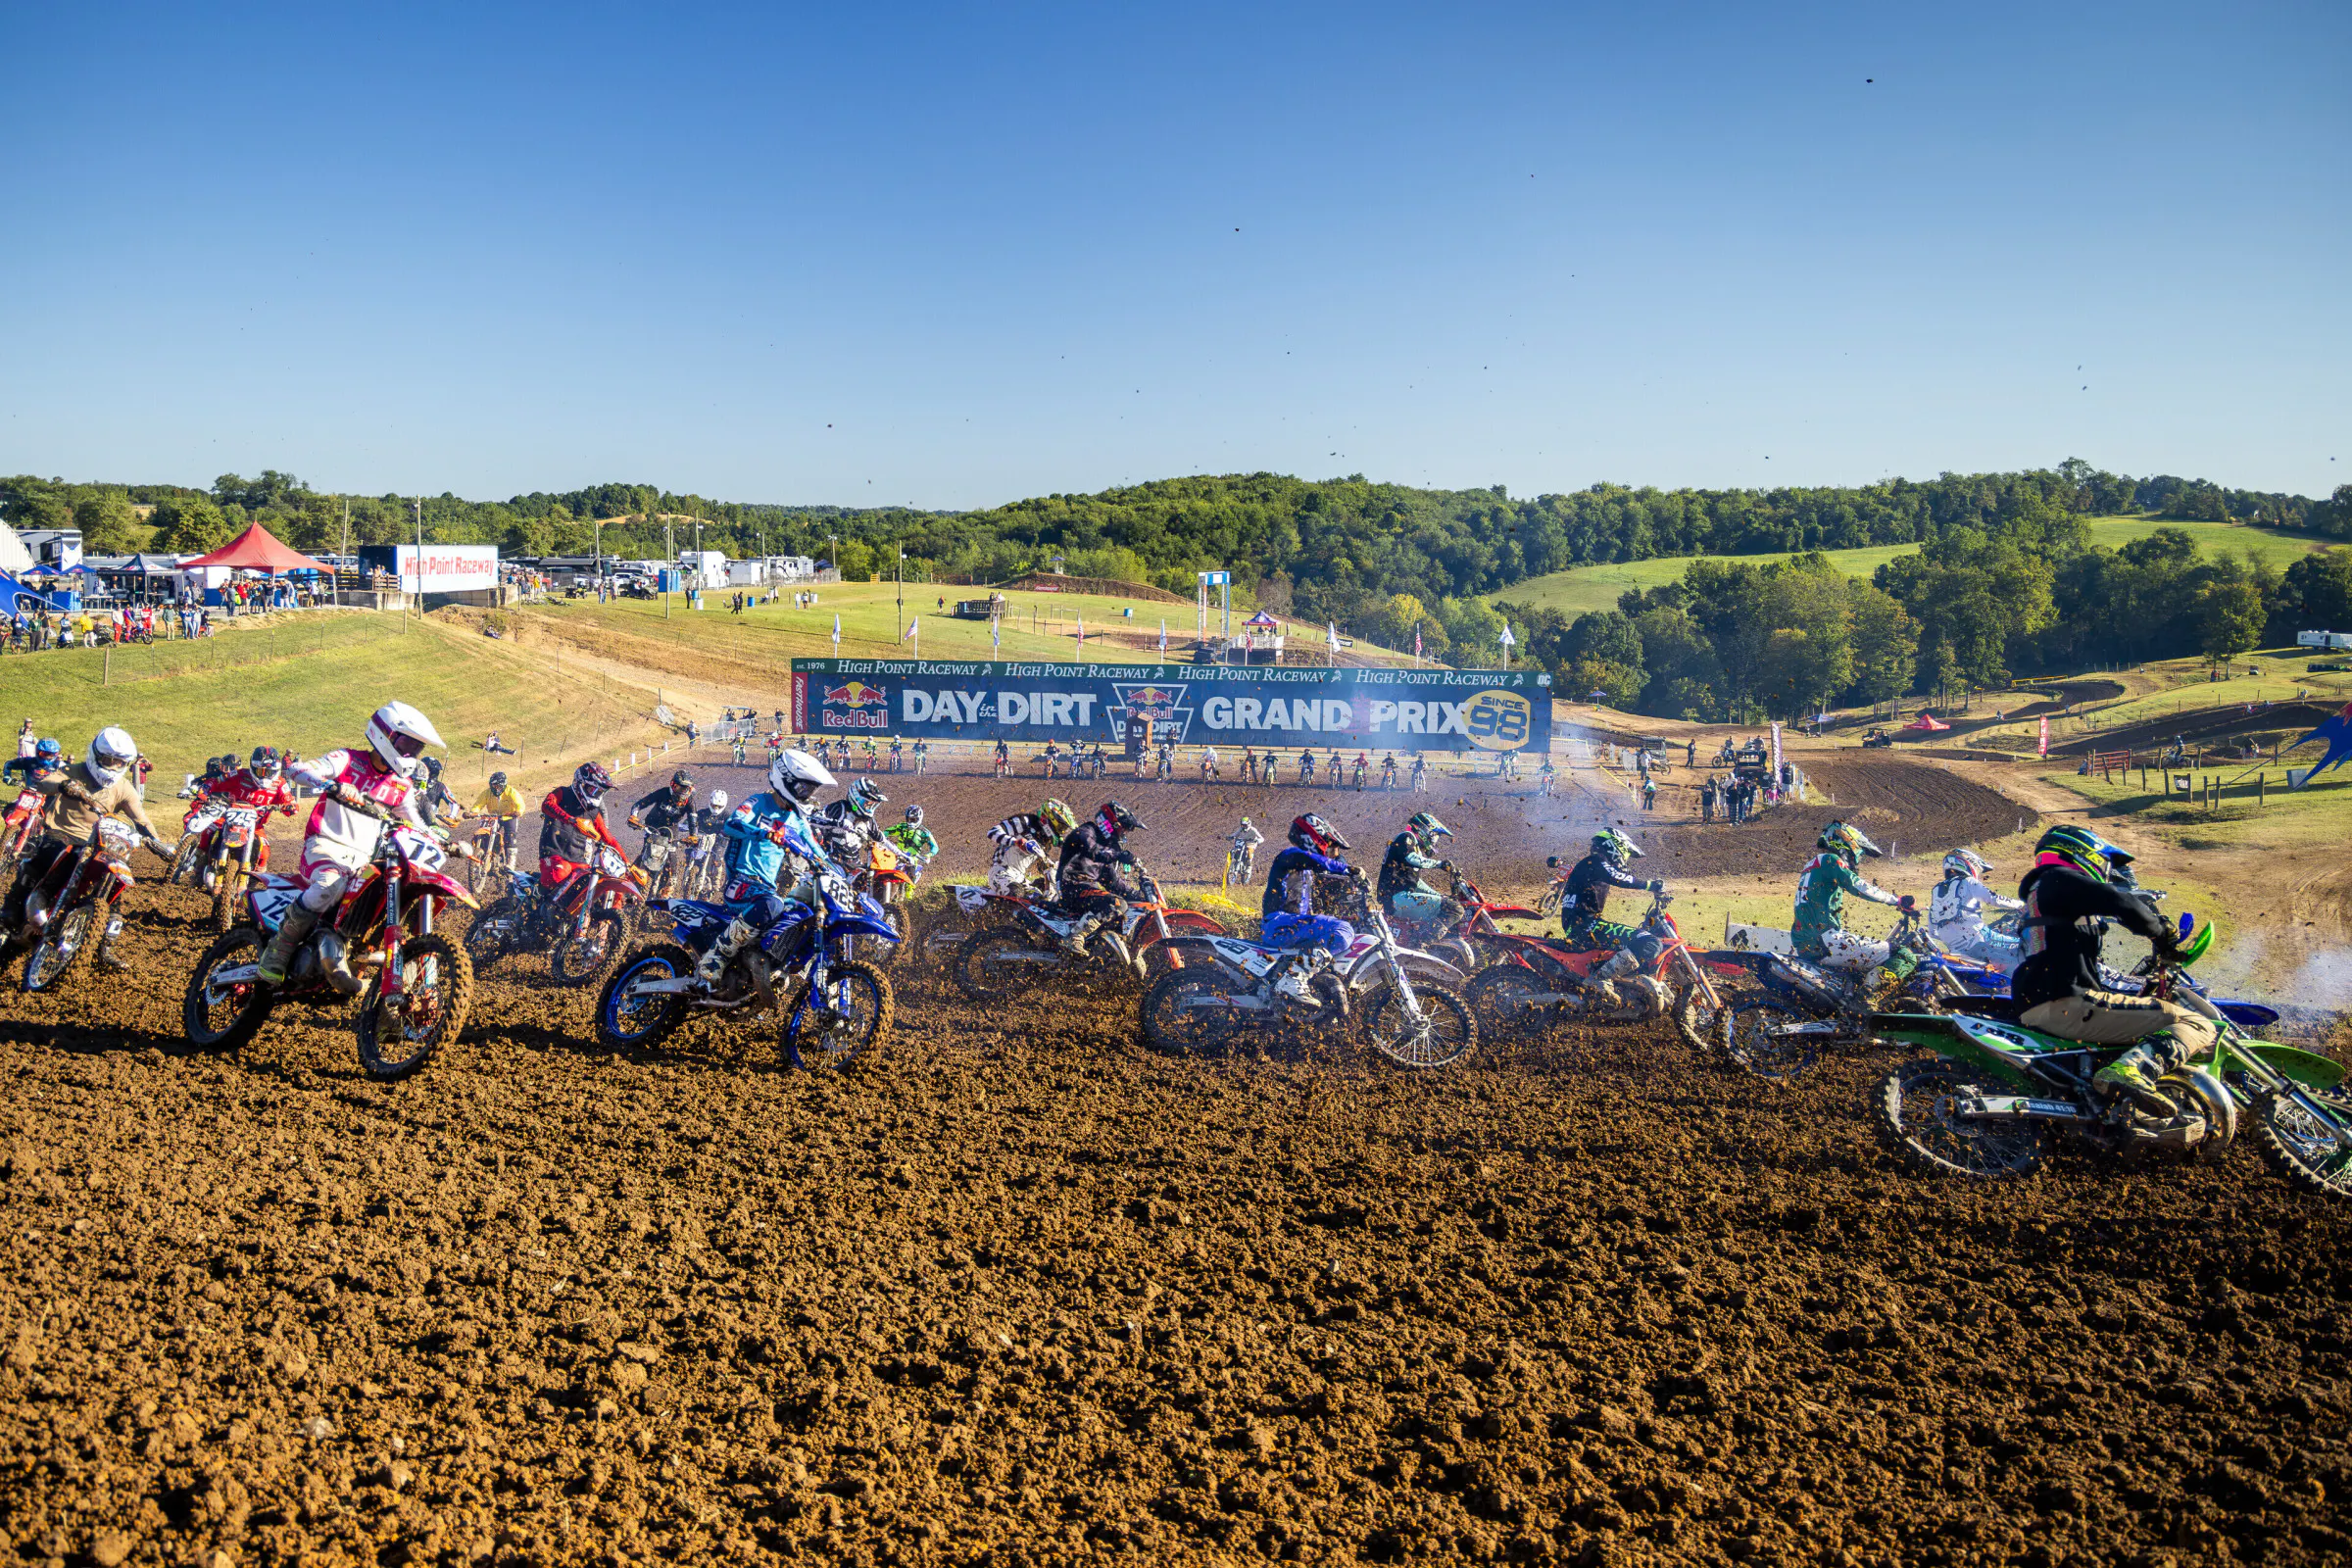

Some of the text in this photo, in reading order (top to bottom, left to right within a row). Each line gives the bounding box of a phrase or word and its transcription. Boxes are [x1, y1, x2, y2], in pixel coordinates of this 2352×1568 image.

[405, 556, 495, 579] High Point Raceway
[795, 675, 805, 730] FASTHOUSE
[823, 709, 888, 728] Red Bull
[903, 689, 987, 723] DAY
[998, 692, 1097, 726] DIRT
[1151, 707, 1174, 720] Bull
[1202, 696, 1472, 735] GRAND PRIX
[1481, 696, 1526, 710] SINCE
[1468, 705, 1528, 742] 98
[408, 836, 441, 871] 72
